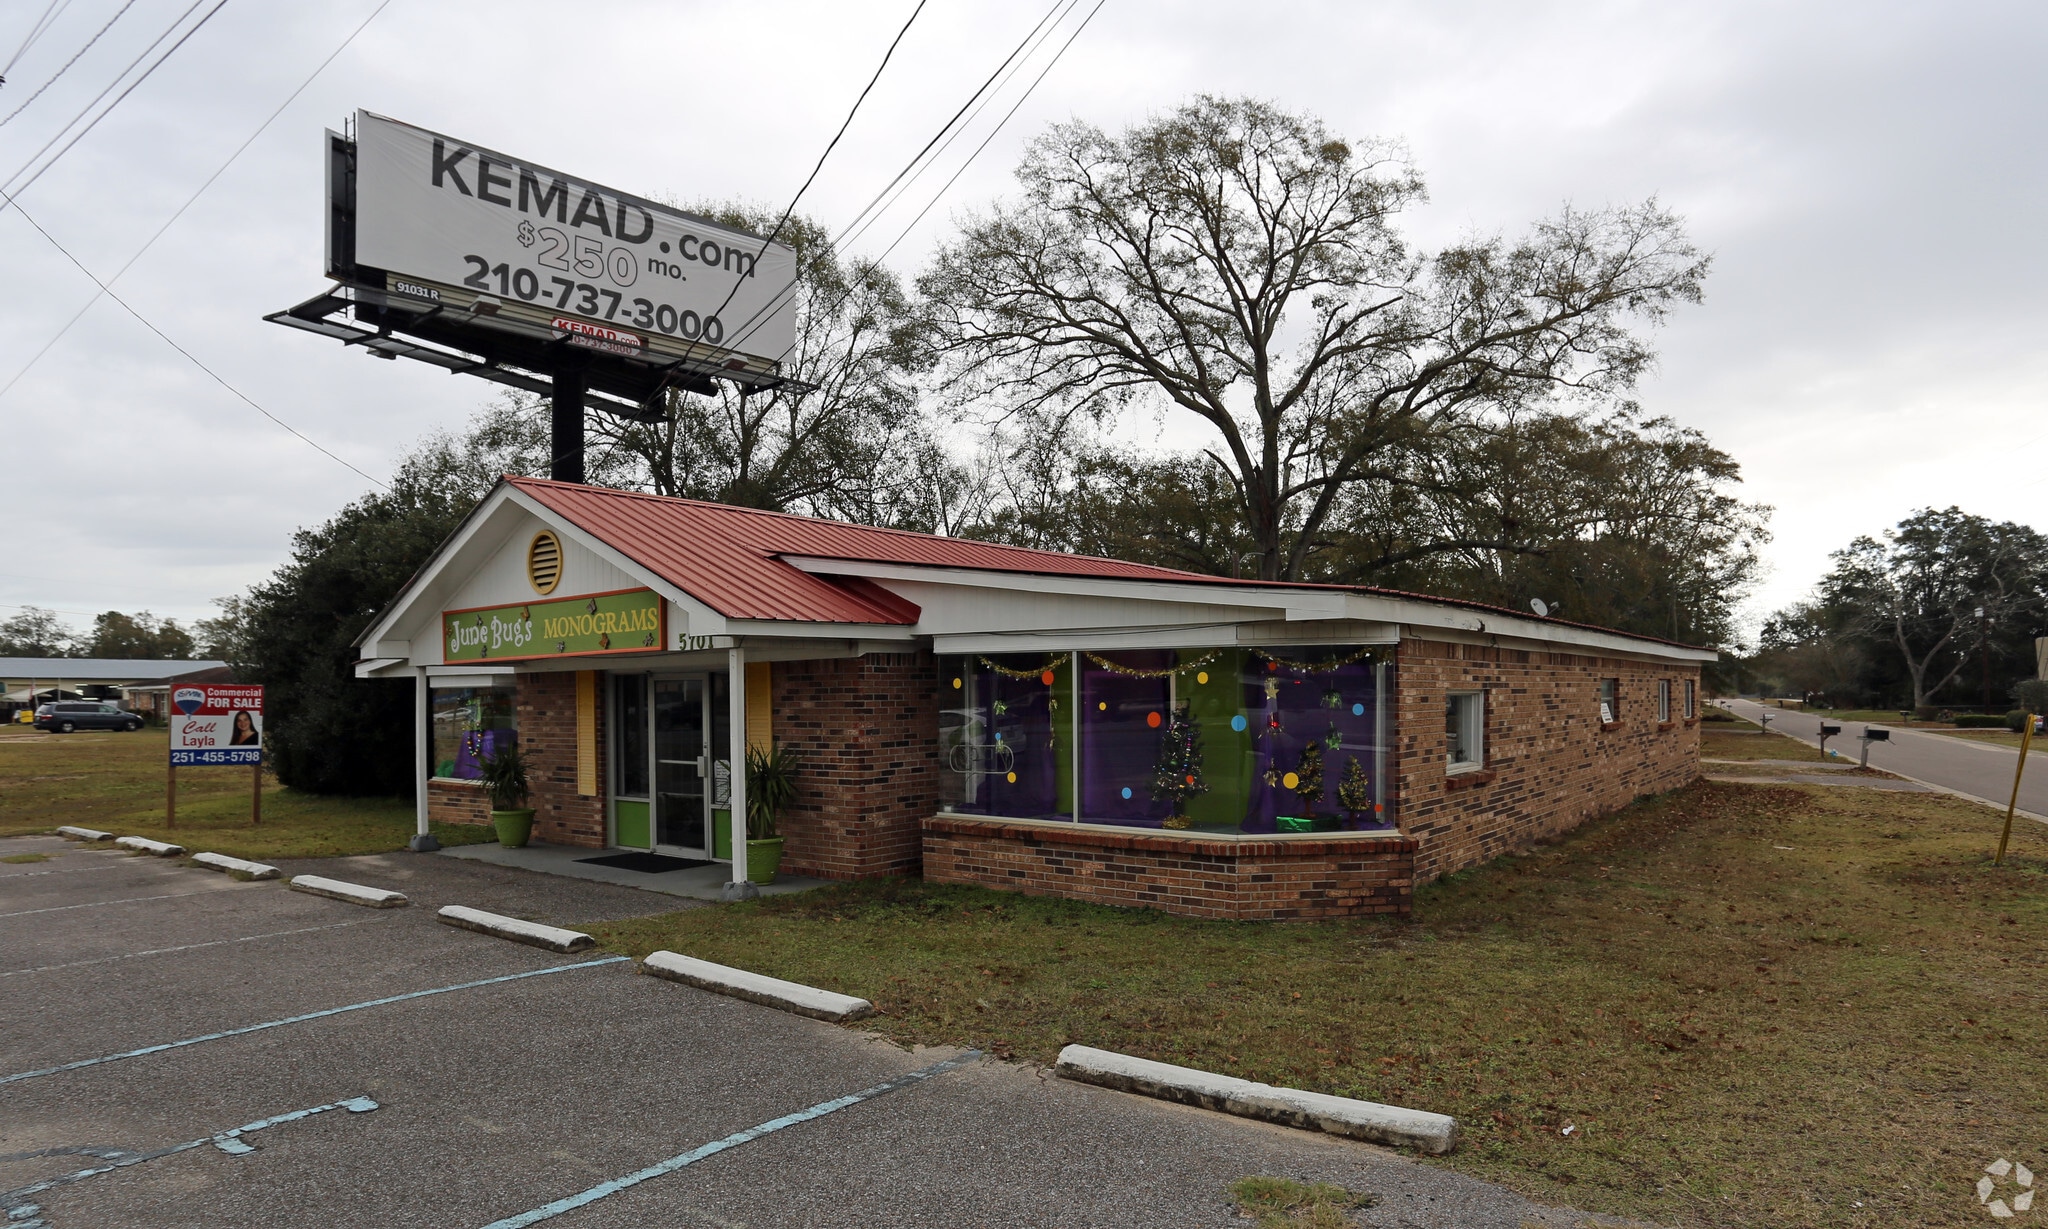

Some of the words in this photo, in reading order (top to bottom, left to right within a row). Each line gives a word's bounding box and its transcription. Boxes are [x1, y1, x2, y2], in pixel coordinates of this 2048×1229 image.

[431, 138, 756, 278] KEMAD.com
[517, 220, 638, 288] $250
[647, 257, 687, 282] mo.
[397, 282, 430, 298] 91031
[430, 290, 440, 300] R
[463, 254, 724, 345] 210-737-3000
[561, 332, 632, 354] 0-737-3000
[451, 620, 488, 653] June
[543, 607, 658, 639] MONOGRAMS
[679, 633, 714, 650] 5701
[207, 688, 262, 697] Commercial
[207, 698, 230, 708] FOR
[233, 698, 262, 708] SALE
[182, 720, 217, 734] Call
[182, 736, 215, 748] Layla
[172, 751, 260, 763] 251-455-5798
